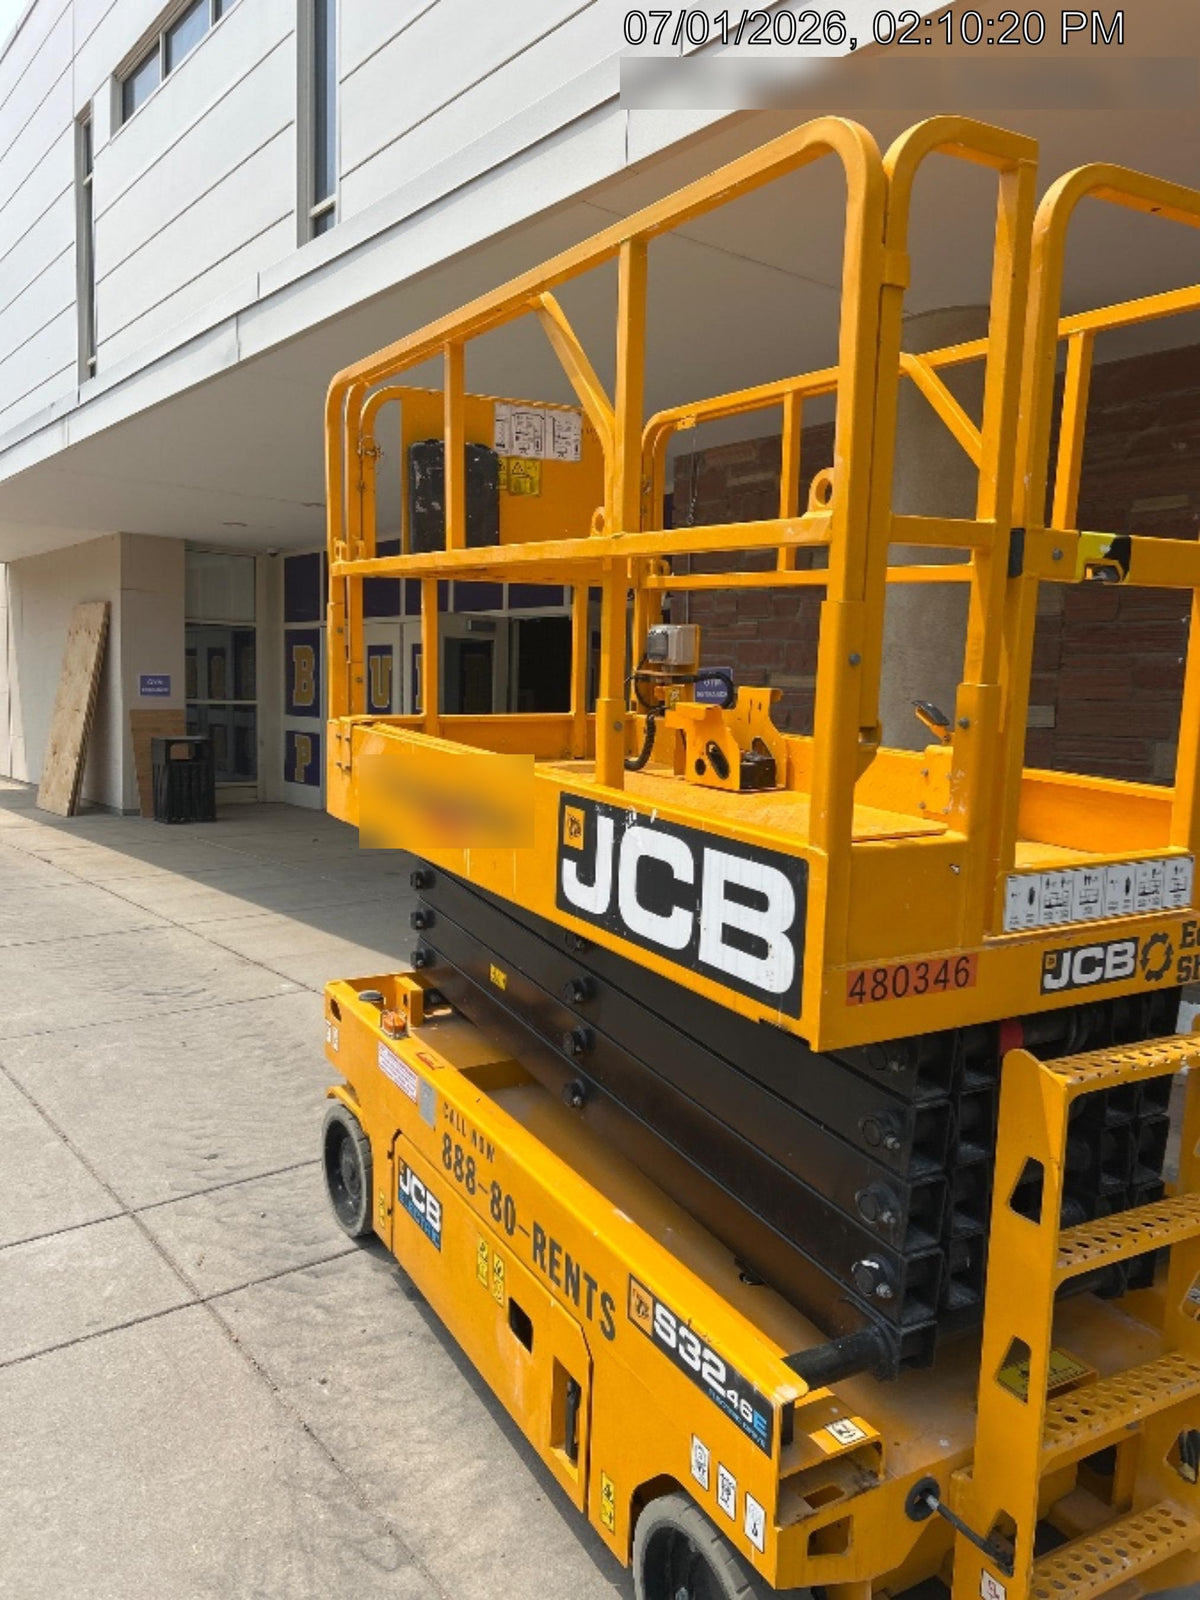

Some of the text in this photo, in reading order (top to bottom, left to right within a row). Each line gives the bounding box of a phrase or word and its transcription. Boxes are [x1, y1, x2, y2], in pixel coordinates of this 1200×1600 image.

[292, 644, 316, 707] B
[369, 654, 393, 709] U
[562, 814, 796, 994] JCB
[848, 956, 971, 1003] 480346
[1042, 940, 1136, 991] JCB
[399, 1166, 441, 1234] JCB
[441, 1131, 617, 1342] 888-80-RENTS
